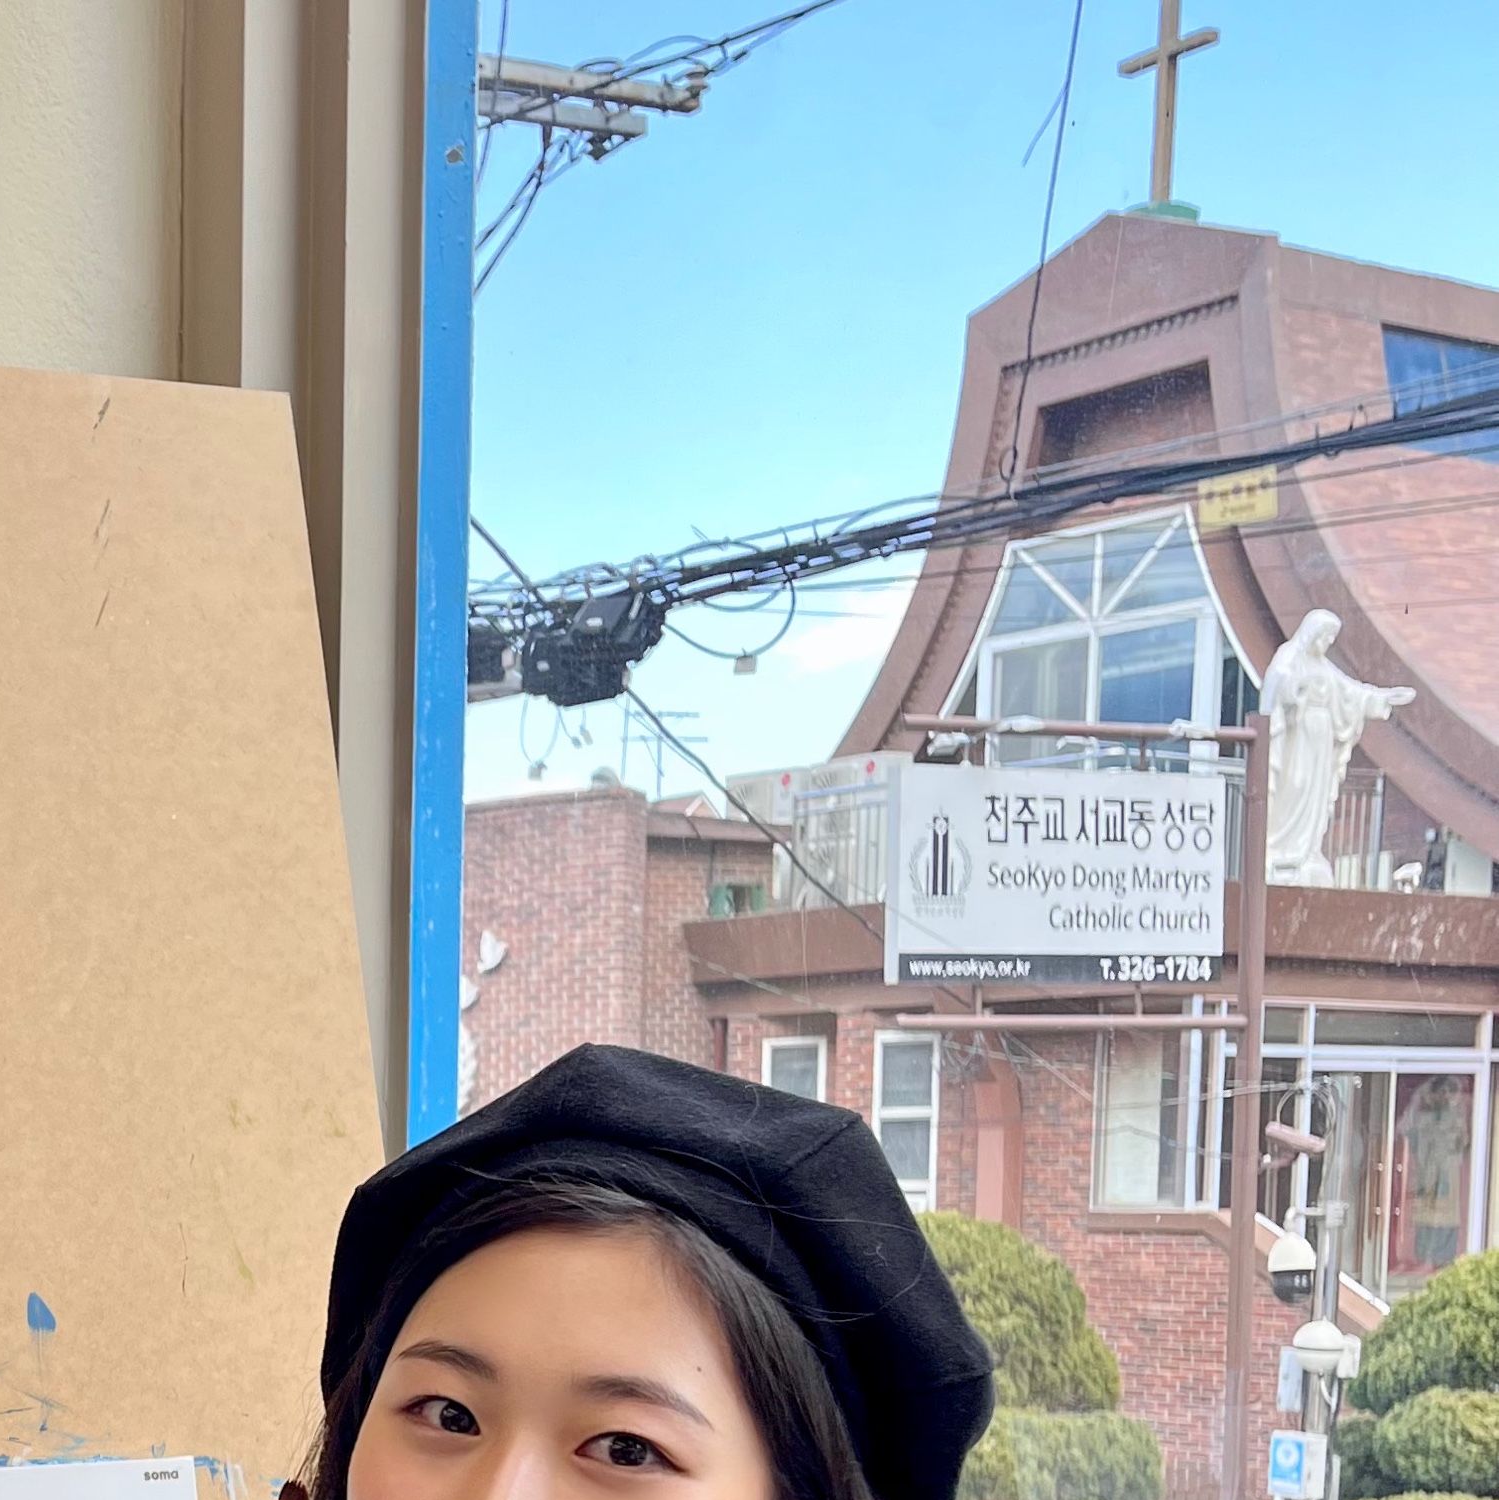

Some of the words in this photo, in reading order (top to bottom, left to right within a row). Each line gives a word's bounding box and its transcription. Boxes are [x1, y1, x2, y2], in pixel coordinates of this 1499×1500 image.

[985, 795, 1068, 844] 천주교
[1075, 796, 1155, 851] 서교동
[1162, 800, 1216, 852] 성당
[987, 861, 1066, 898] SeoKyo
[1072, 862, 1126, 899] Dong
[1131, 863, 1212, 900] Martyrs
[1049, 903, 1134, 933] Catholic
[1138, 904, 1211, 933] Church
[1099, 955, 1213, 982] T.326-1784
[143, 1470, 179, 1481] soma
